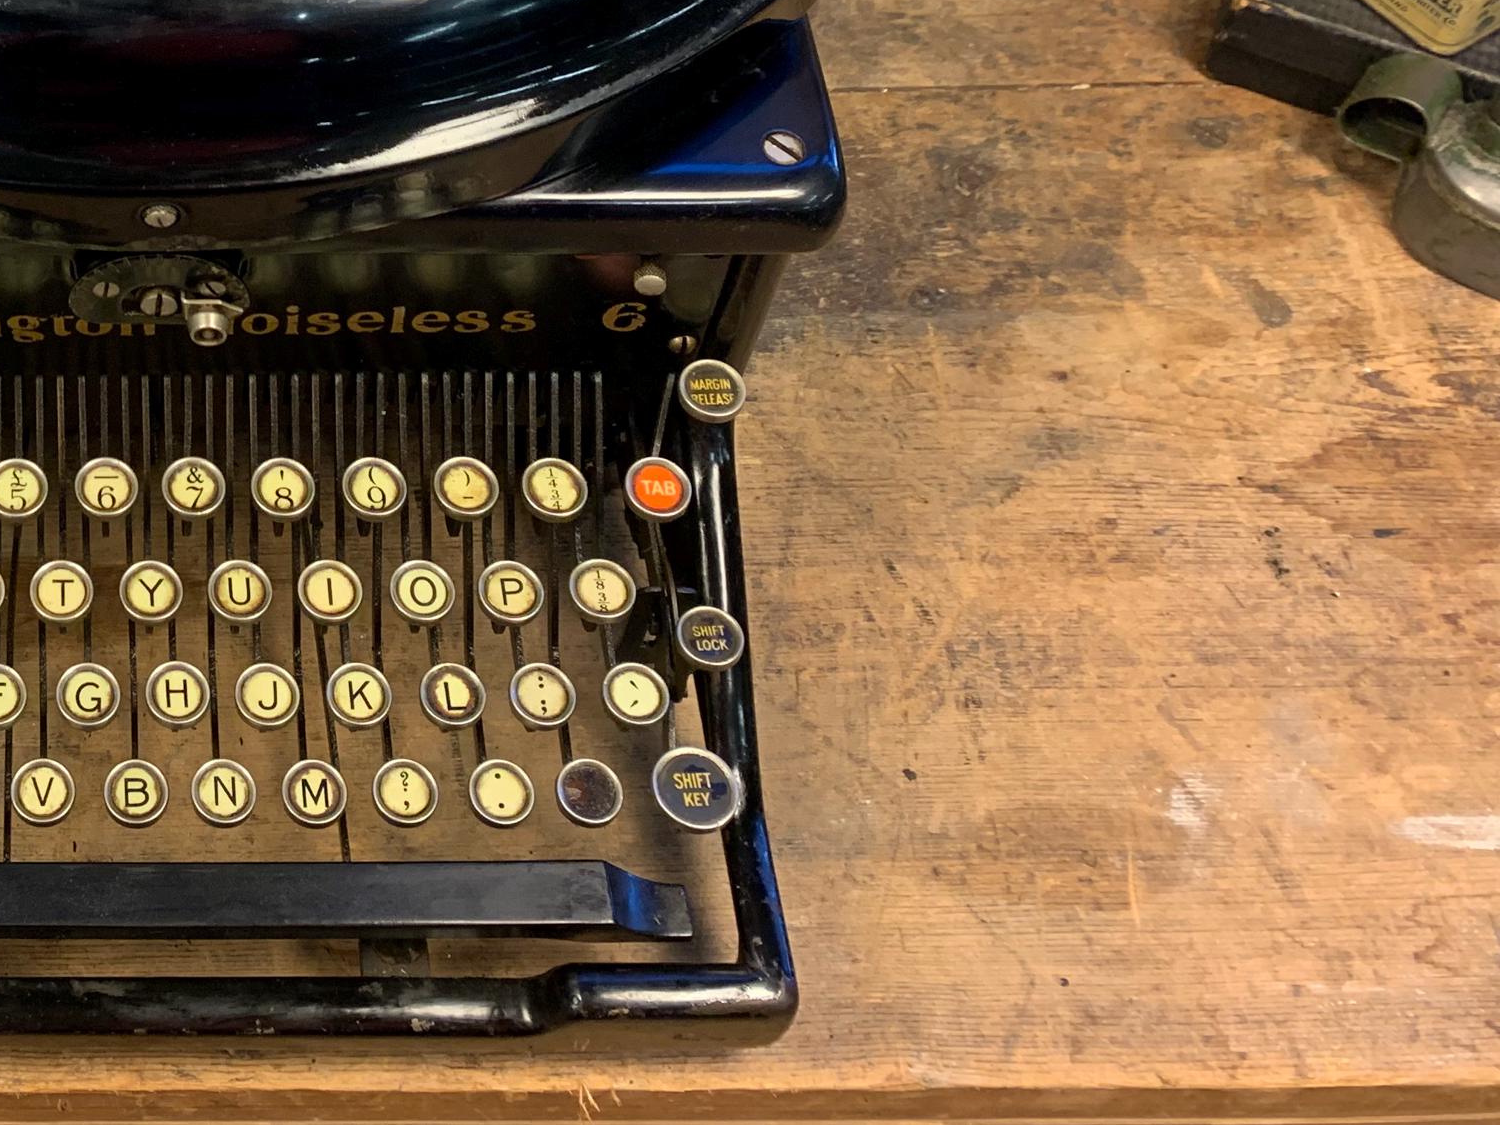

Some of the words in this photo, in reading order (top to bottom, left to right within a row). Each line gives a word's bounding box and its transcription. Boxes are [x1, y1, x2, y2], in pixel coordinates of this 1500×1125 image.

[226, 305, 537, 336] oiseless
[602, 302, 647, 332] 6
[689, 378, 732, 391] MARGIN
[10, 488, 26, 510] 5
[98, 488, 115, 509] 6
[186, 487, 203, 509] 7
[275, 487, 293, 510] 8
[368, 488, 385, 509] 9
[640, 478, 676, 497] TAB
[52, 579, 75, 607] T
[139, 579, 164, 607] Y
[229, 577, 251, 605] U
[409, 577, 437, 606] O
[500, 578, 523, 605] P
[692, 626, 725, 639] SHIFT
[696, 638, 728, 651] LOCK
[75, 682, 101, 711] G
[165, 680, 189, 707] H
[259, 681, 278, 710] J
[349, 681, 373, 709] K
[445, 682, 465, 711] L
[31, 777, 54, 807] V
[125, 778, 148, 807] B
[215, 777, 236, 806] N
[302, 778, 329, 807] M
[674, 771, 712, 790] SHIFT
[683, 789, 710, 807] KEY
